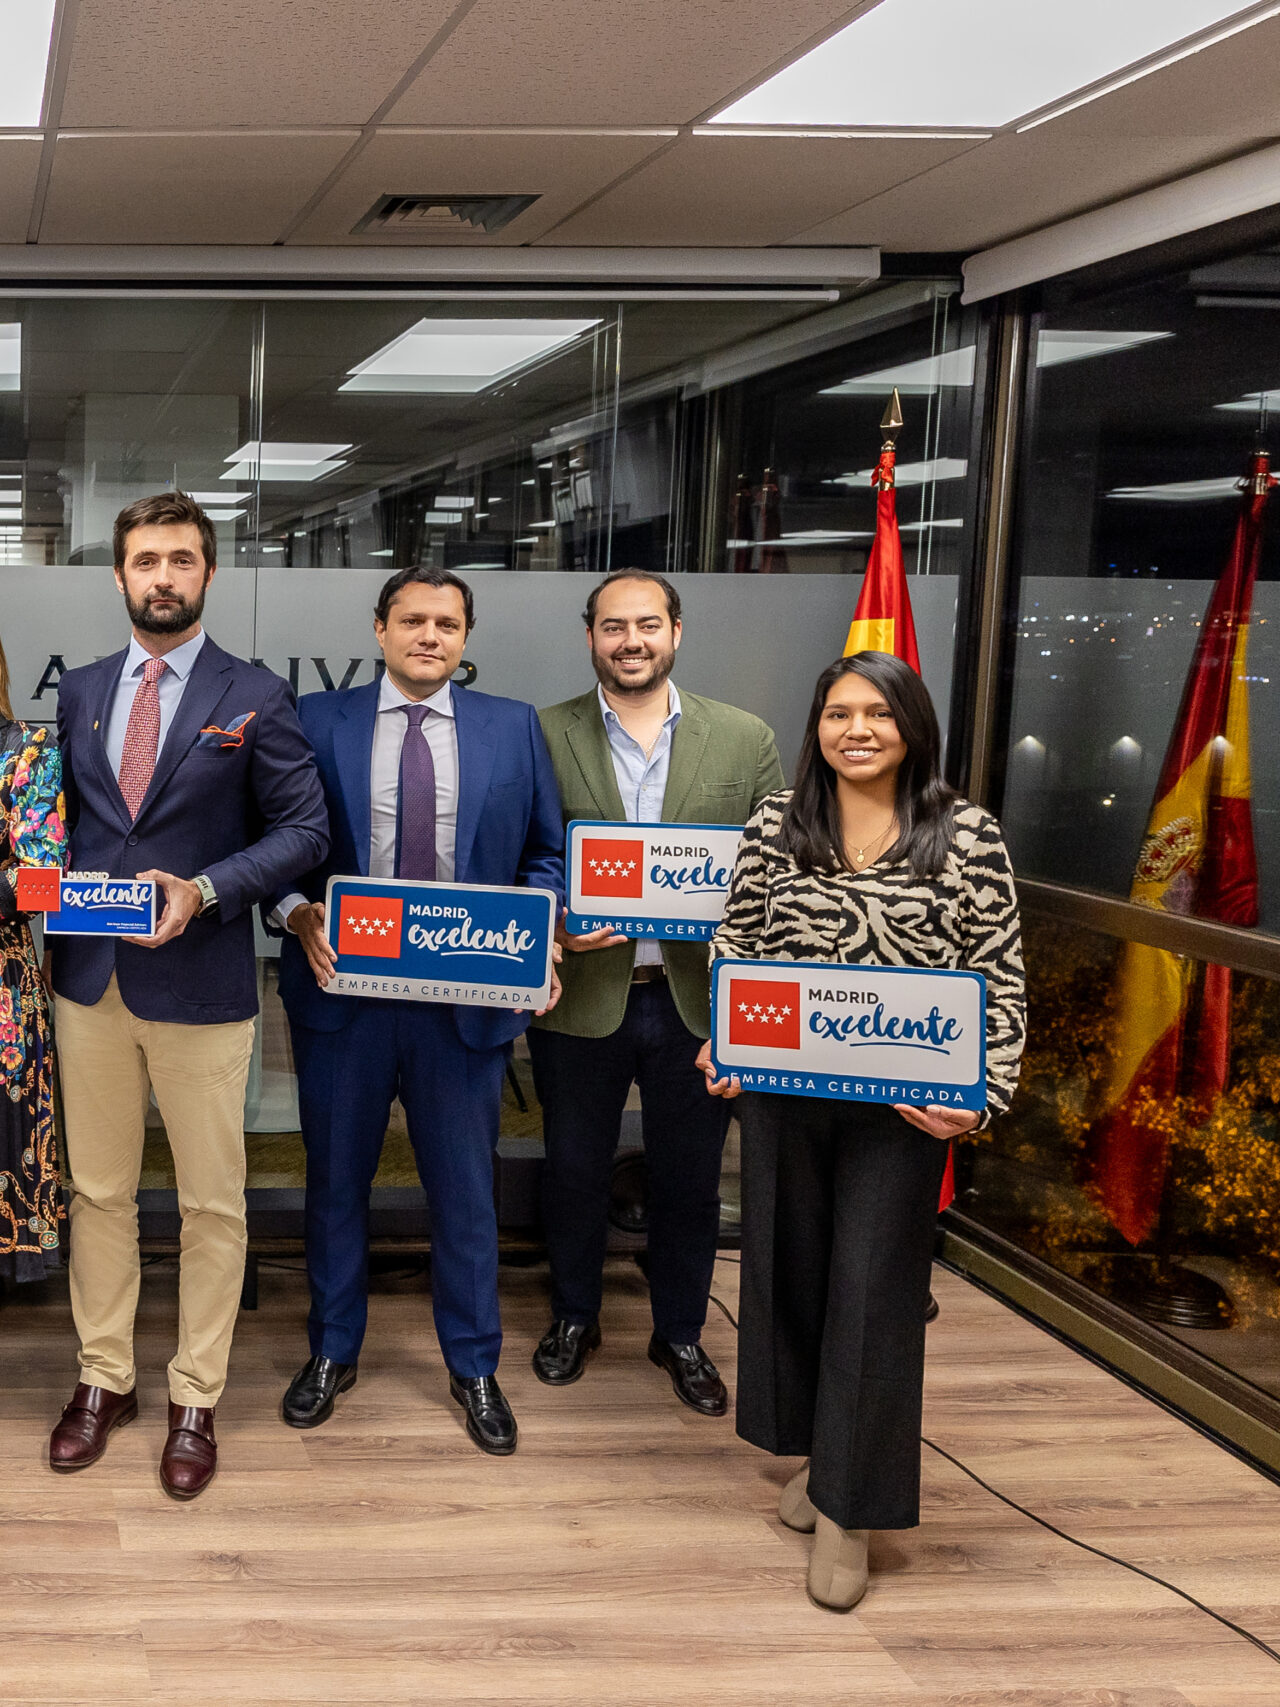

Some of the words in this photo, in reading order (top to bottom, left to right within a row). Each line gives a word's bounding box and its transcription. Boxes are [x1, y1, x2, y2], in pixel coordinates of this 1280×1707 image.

[650, 845, 709, 858] MADRID
[66, 870, 110, 881] MADRID
[650, 856, 734, 890] excele
[62, 881, 153, 908] excelente
[408, 904, 468, 919] MADRID
[407, 917, 536, 955] excelente
[338, 979, 411, 994] EMPRESA
[421, 985, 532, 1004] CERTIFICADA
[808, 988, 879, 1004] MADRID
[809, 1003, 964, 1046] excelente
[828, 1080, 965, 1103] CERTIFICADA
